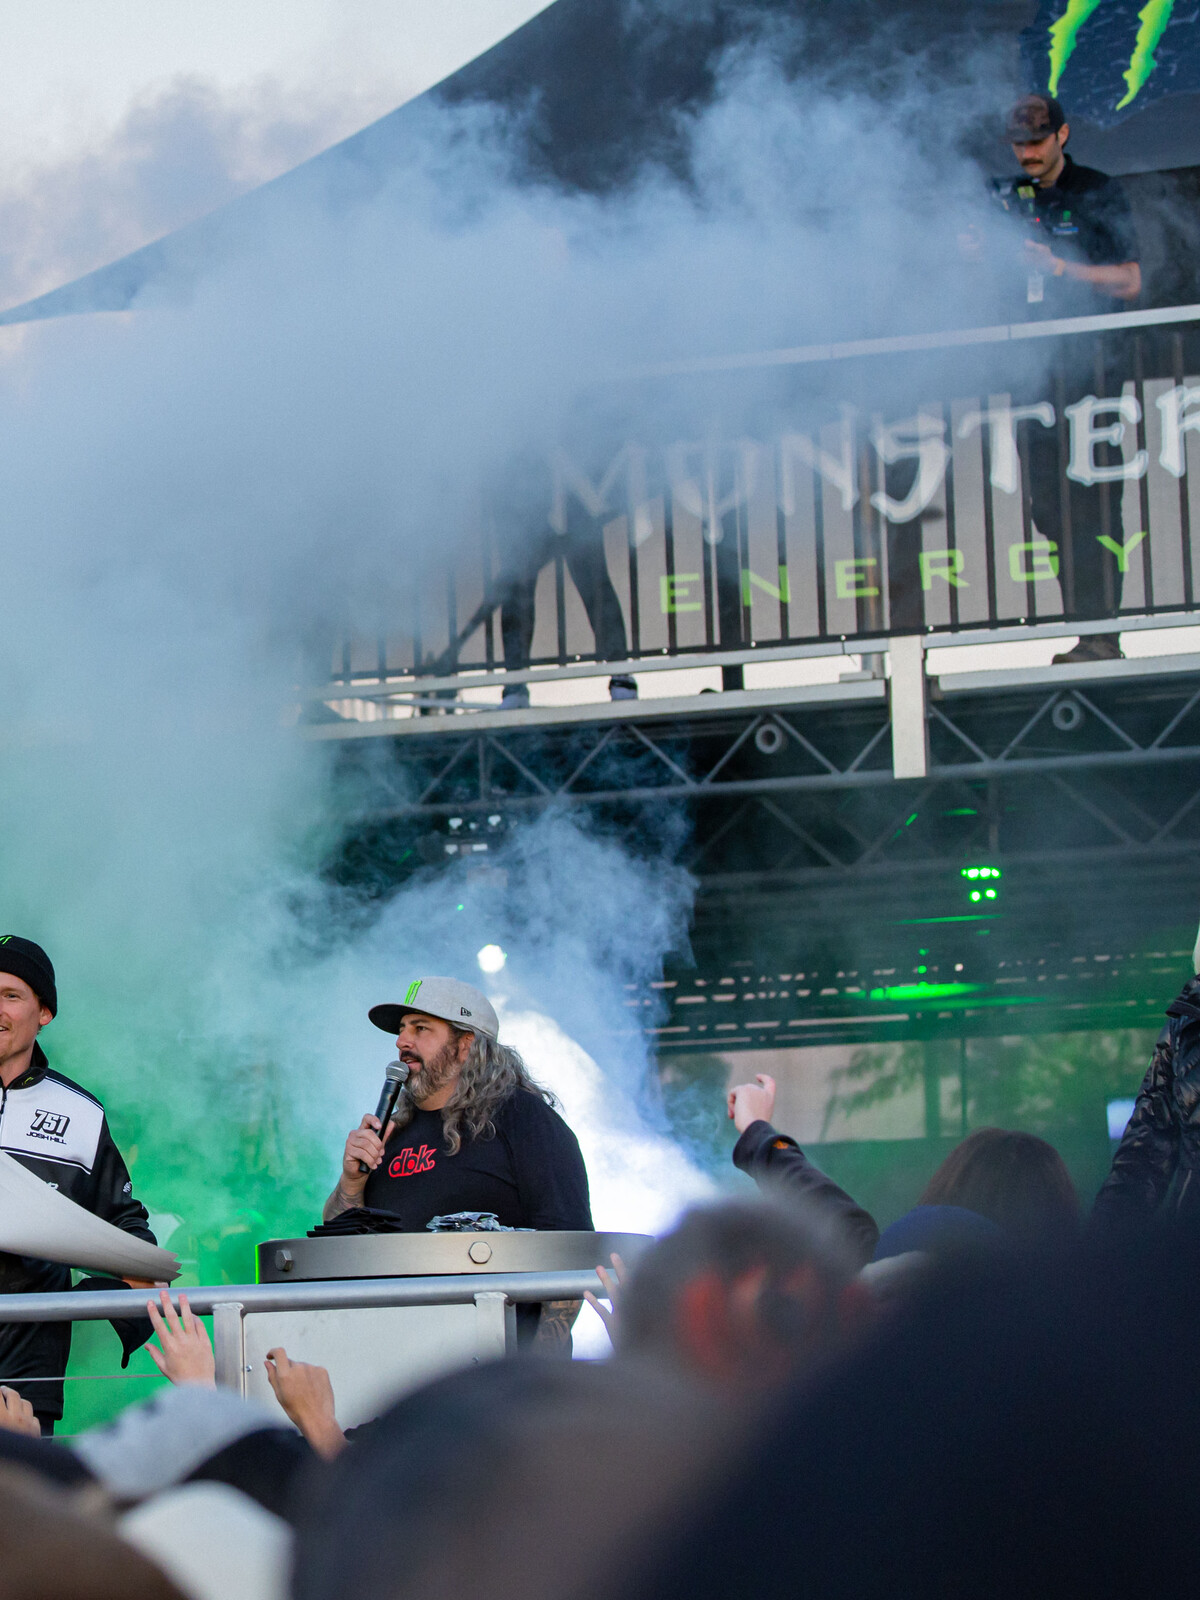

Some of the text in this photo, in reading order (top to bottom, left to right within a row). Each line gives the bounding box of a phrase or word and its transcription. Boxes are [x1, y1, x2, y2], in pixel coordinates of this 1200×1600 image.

[659, 530, 1148, 614] ENERGY
[31, 1109, 71, 1137] 751
[26, 1131, 67, 1145] JOSH HILL
